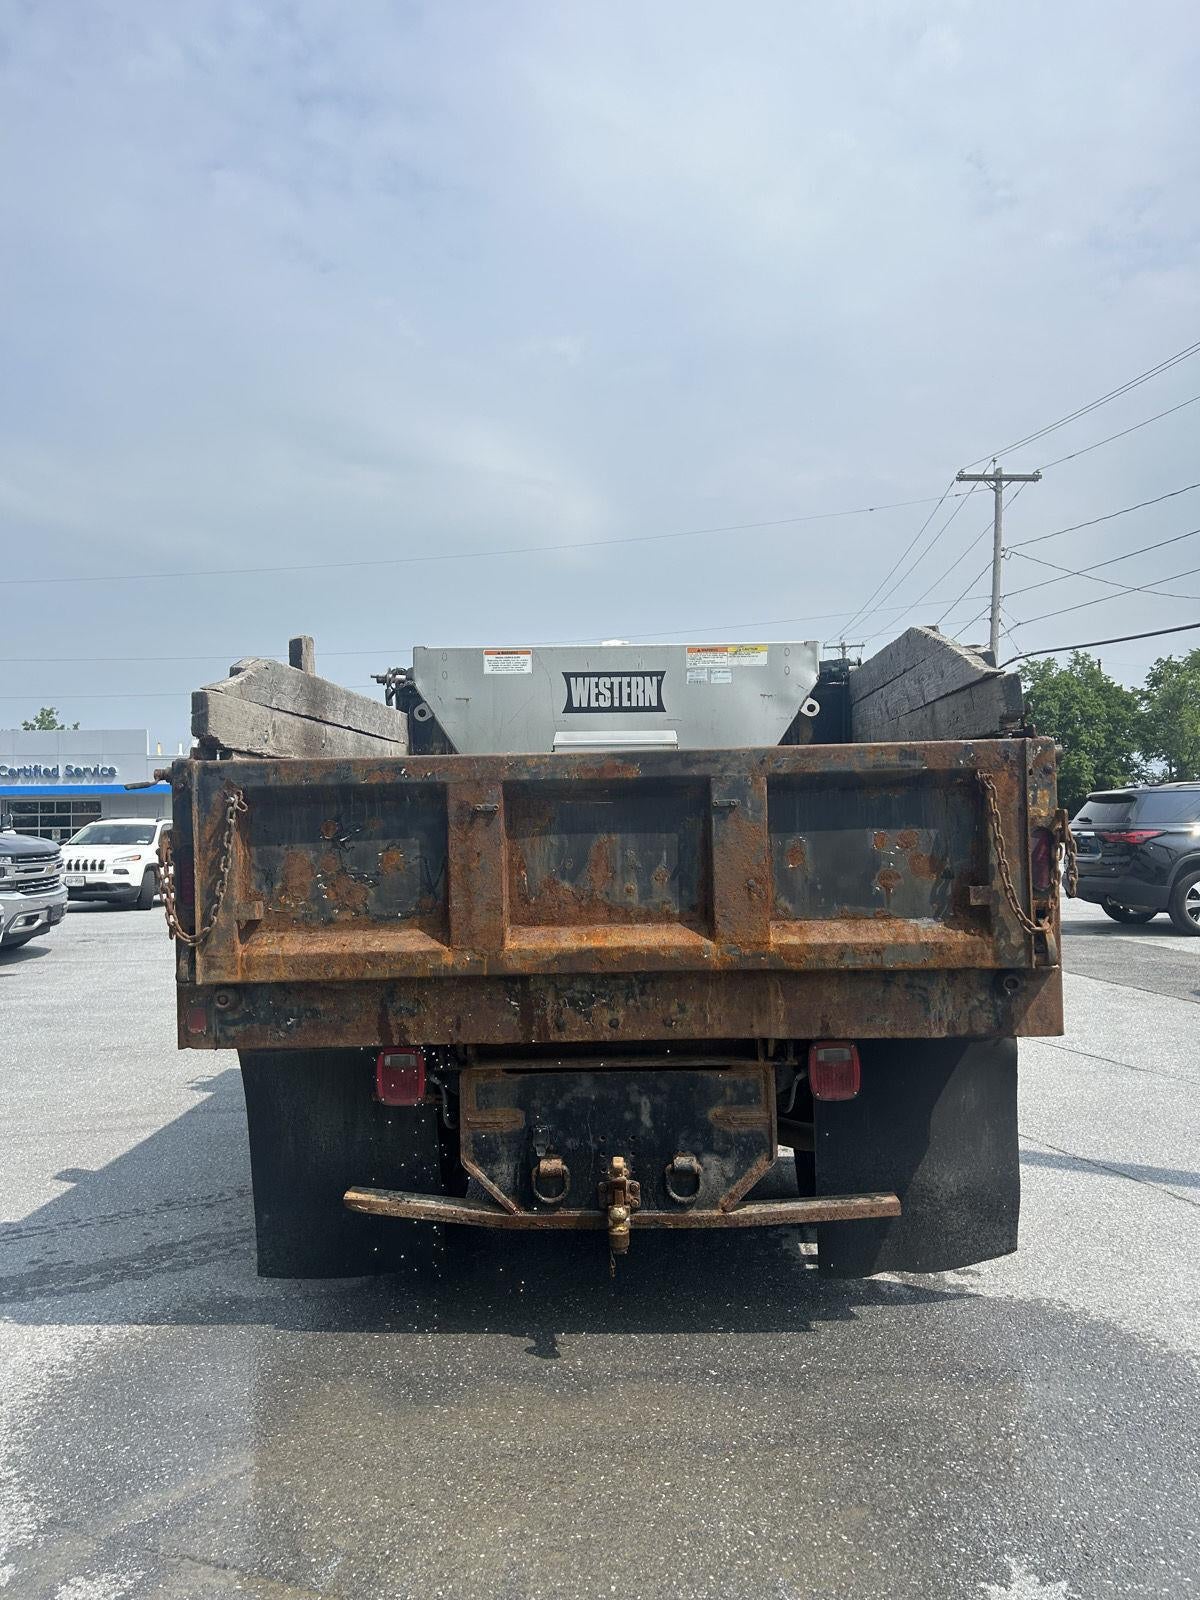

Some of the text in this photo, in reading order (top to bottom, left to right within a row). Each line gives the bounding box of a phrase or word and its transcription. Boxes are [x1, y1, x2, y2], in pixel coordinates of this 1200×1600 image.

[570, 676, 658, 707] WESTERN
[0, 764, 117, 777] Certified Service
